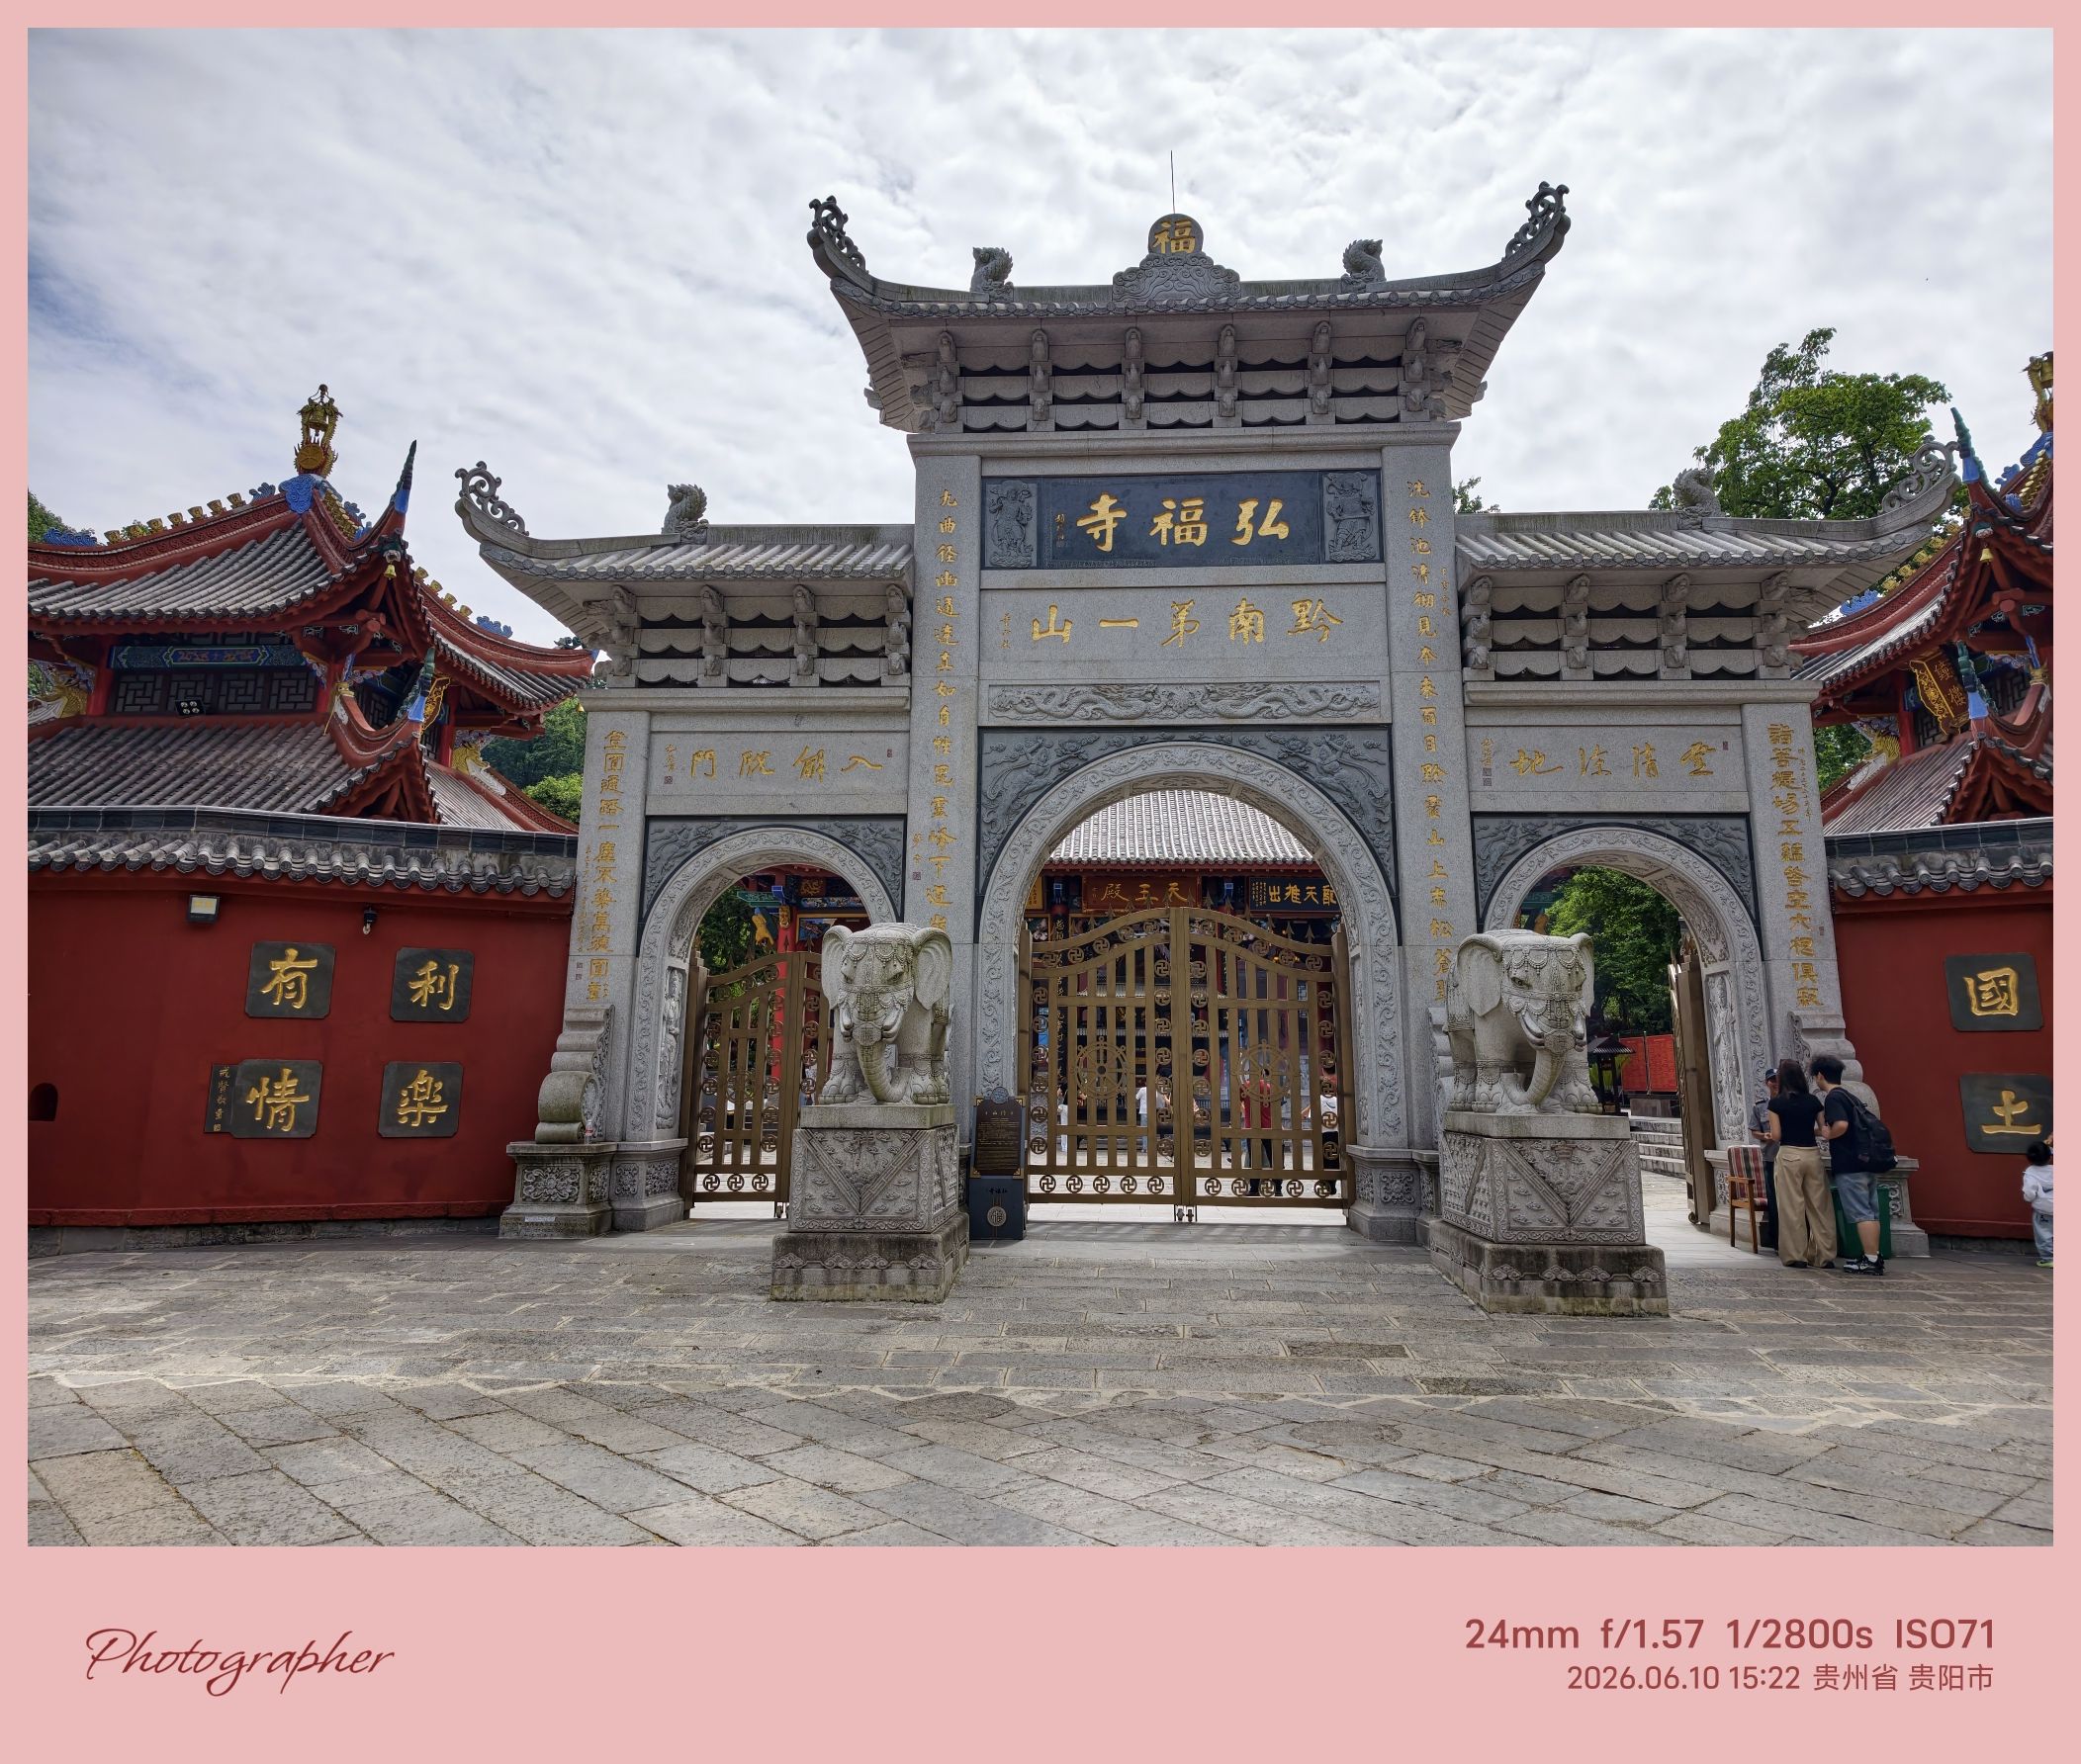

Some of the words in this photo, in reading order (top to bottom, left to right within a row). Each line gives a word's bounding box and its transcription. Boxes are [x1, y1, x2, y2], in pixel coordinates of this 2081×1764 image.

[1151, 220, 1196, 254] 福
[1076, 492, 1290, 552] 弘福寺
[261, 948, 317, 1009] 有
[408, 960, 459, 1010] 利
[1963, 967, 2019, 1015] 國
[246, 1068, 310, 1132] 情
[1981, 1090, 2041, 1134] 土
